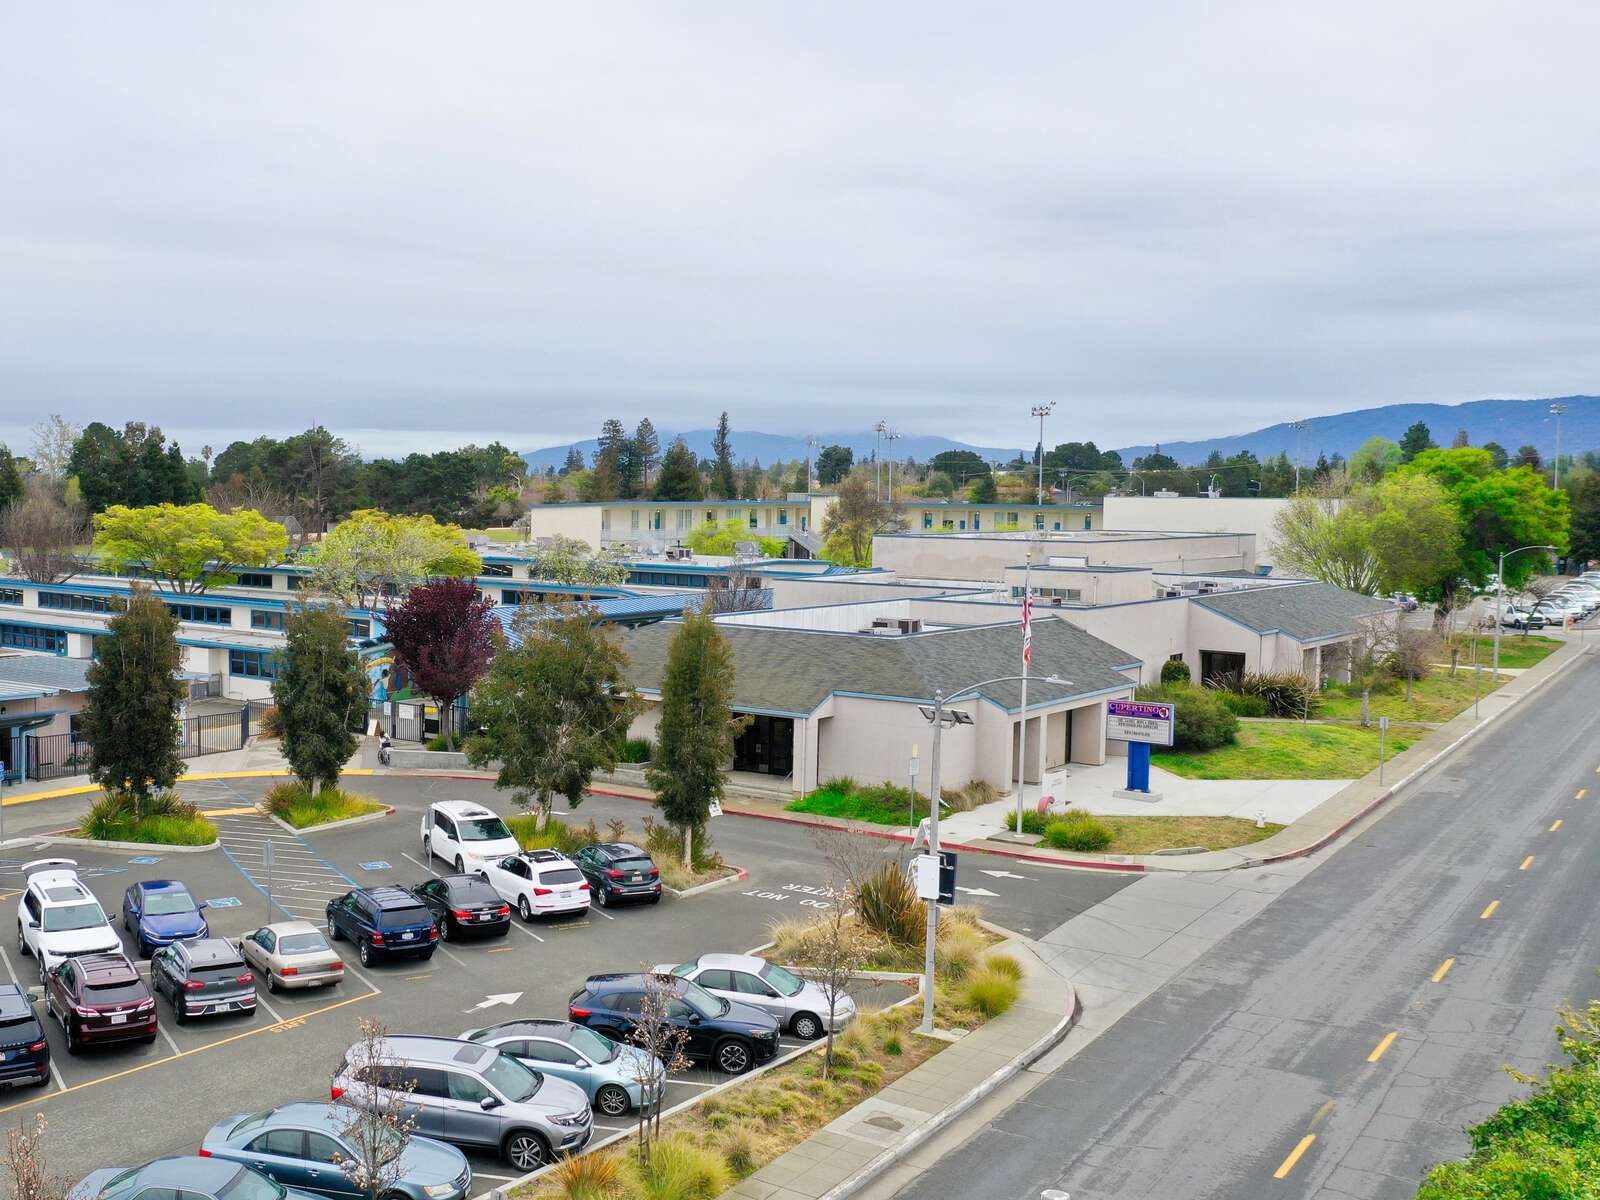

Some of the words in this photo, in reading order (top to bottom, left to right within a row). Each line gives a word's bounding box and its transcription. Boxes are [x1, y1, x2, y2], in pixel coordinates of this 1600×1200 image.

[1109, 703, 1159, 713] CUPERTINO
[741, 890, 790, 900] NOT
[799, 899, 831, 909] DO
